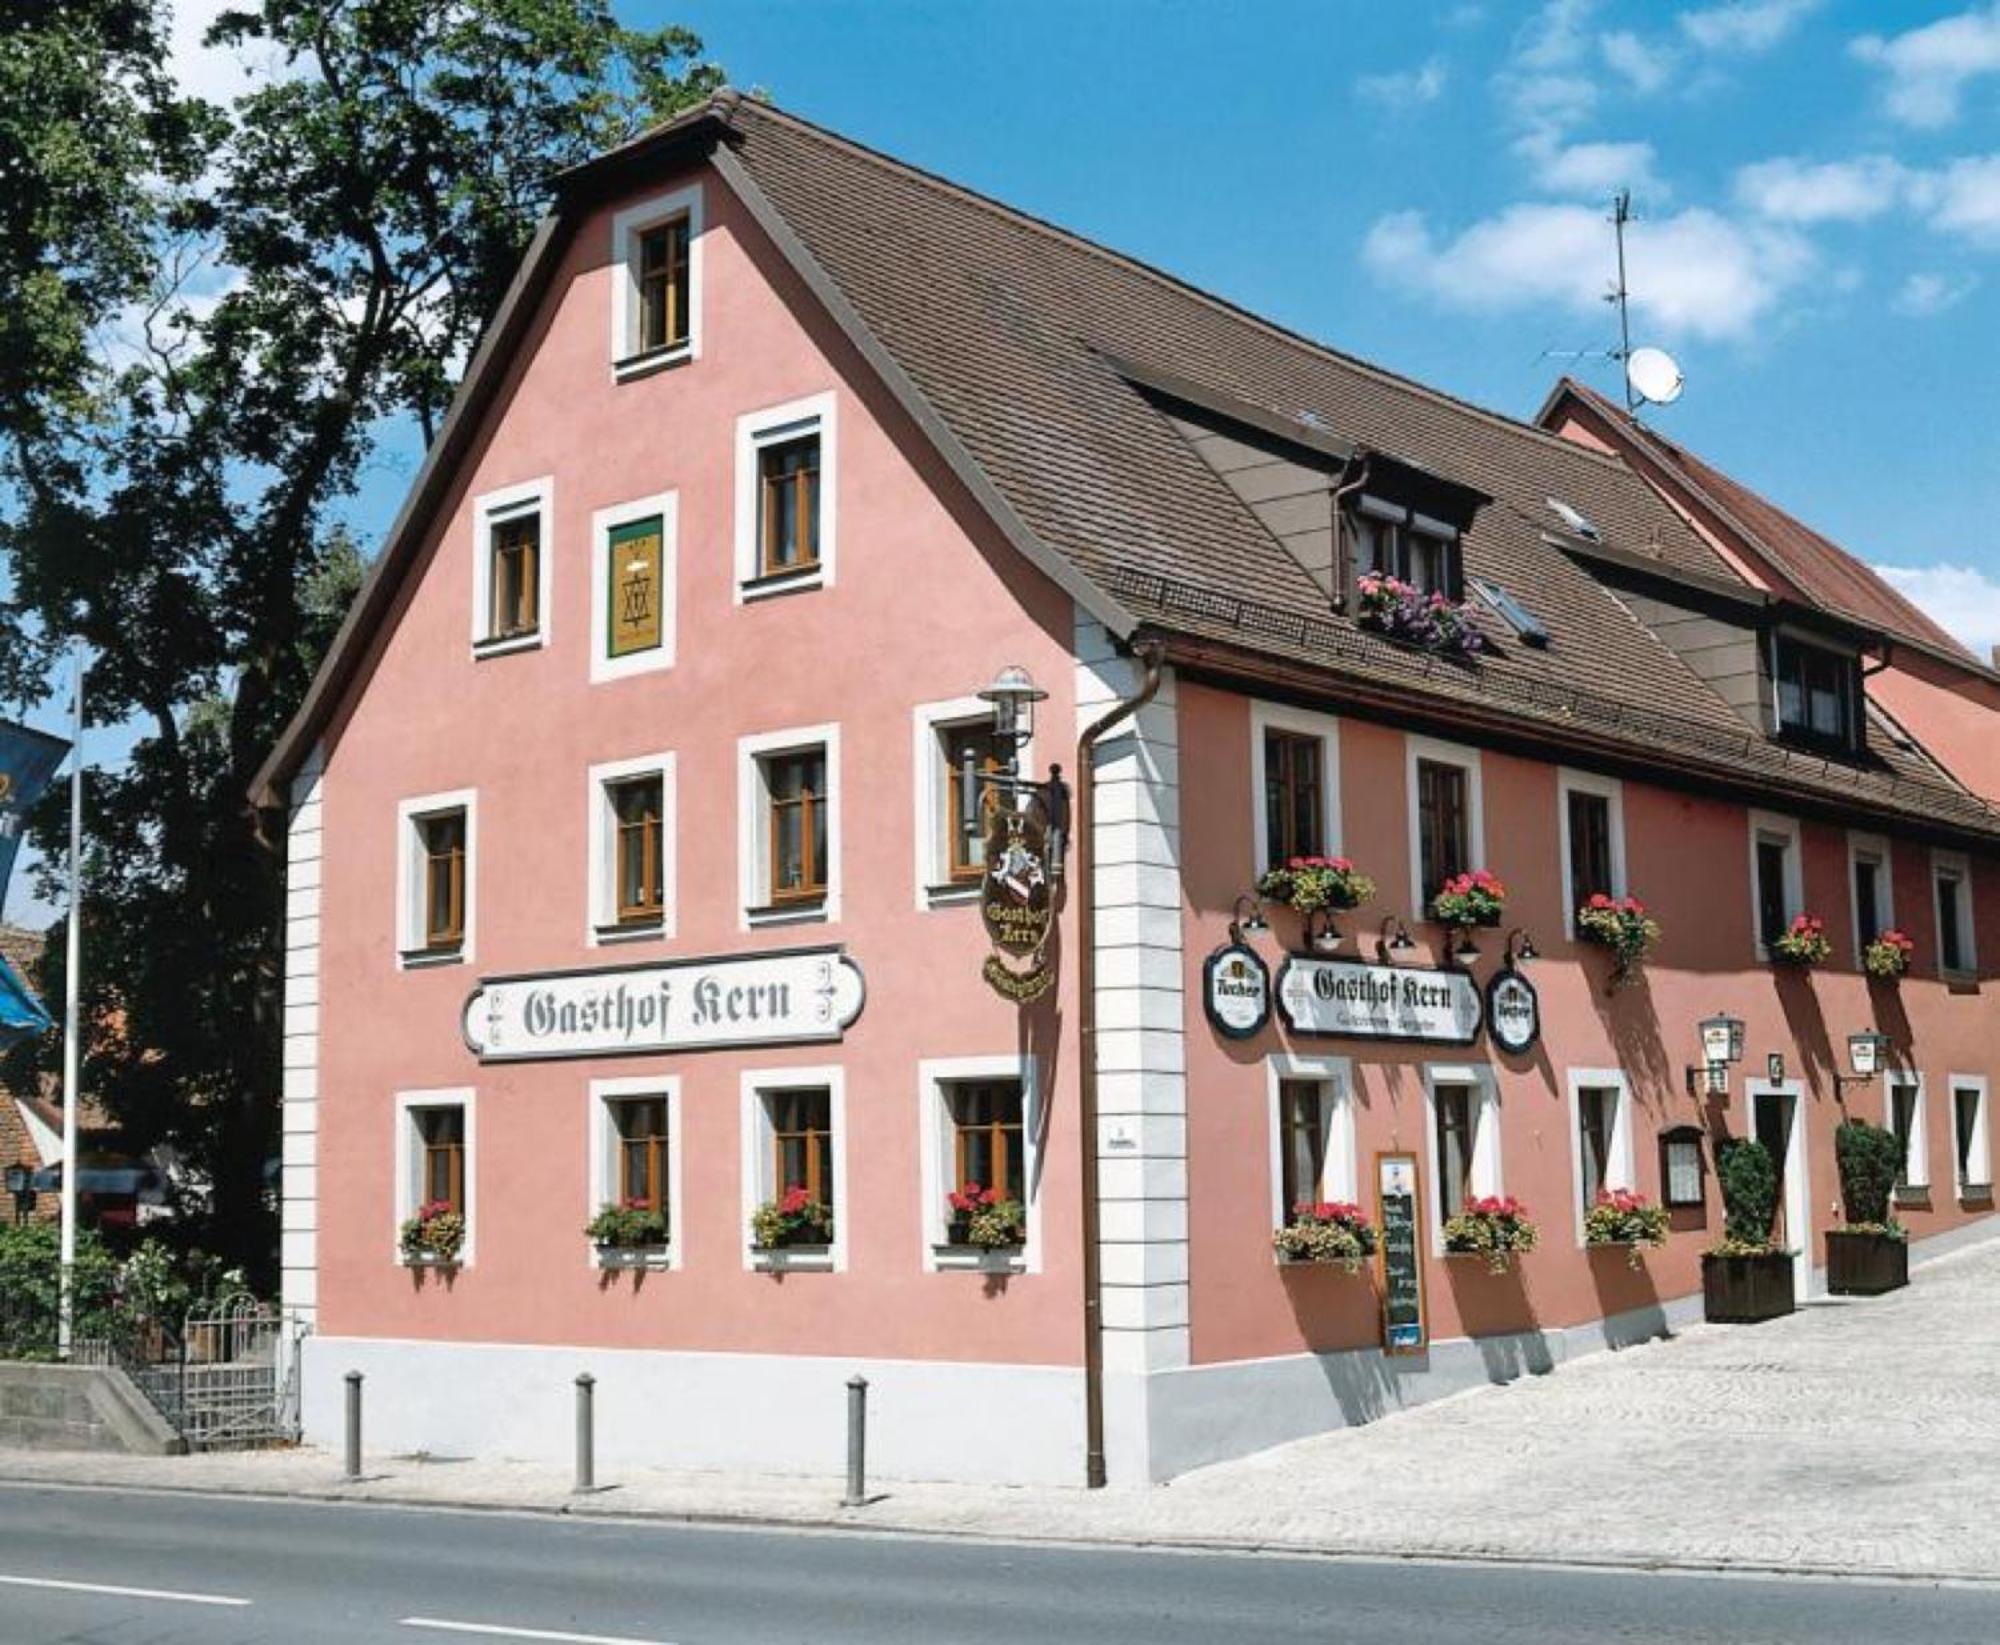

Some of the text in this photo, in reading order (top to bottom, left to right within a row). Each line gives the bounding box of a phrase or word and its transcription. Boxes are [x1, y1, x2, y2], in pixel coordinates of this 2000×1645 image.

[523, 974, 790, 1041] Gasthof Kern
[1313, 967, 1452, 1013] Gasthof Kern
